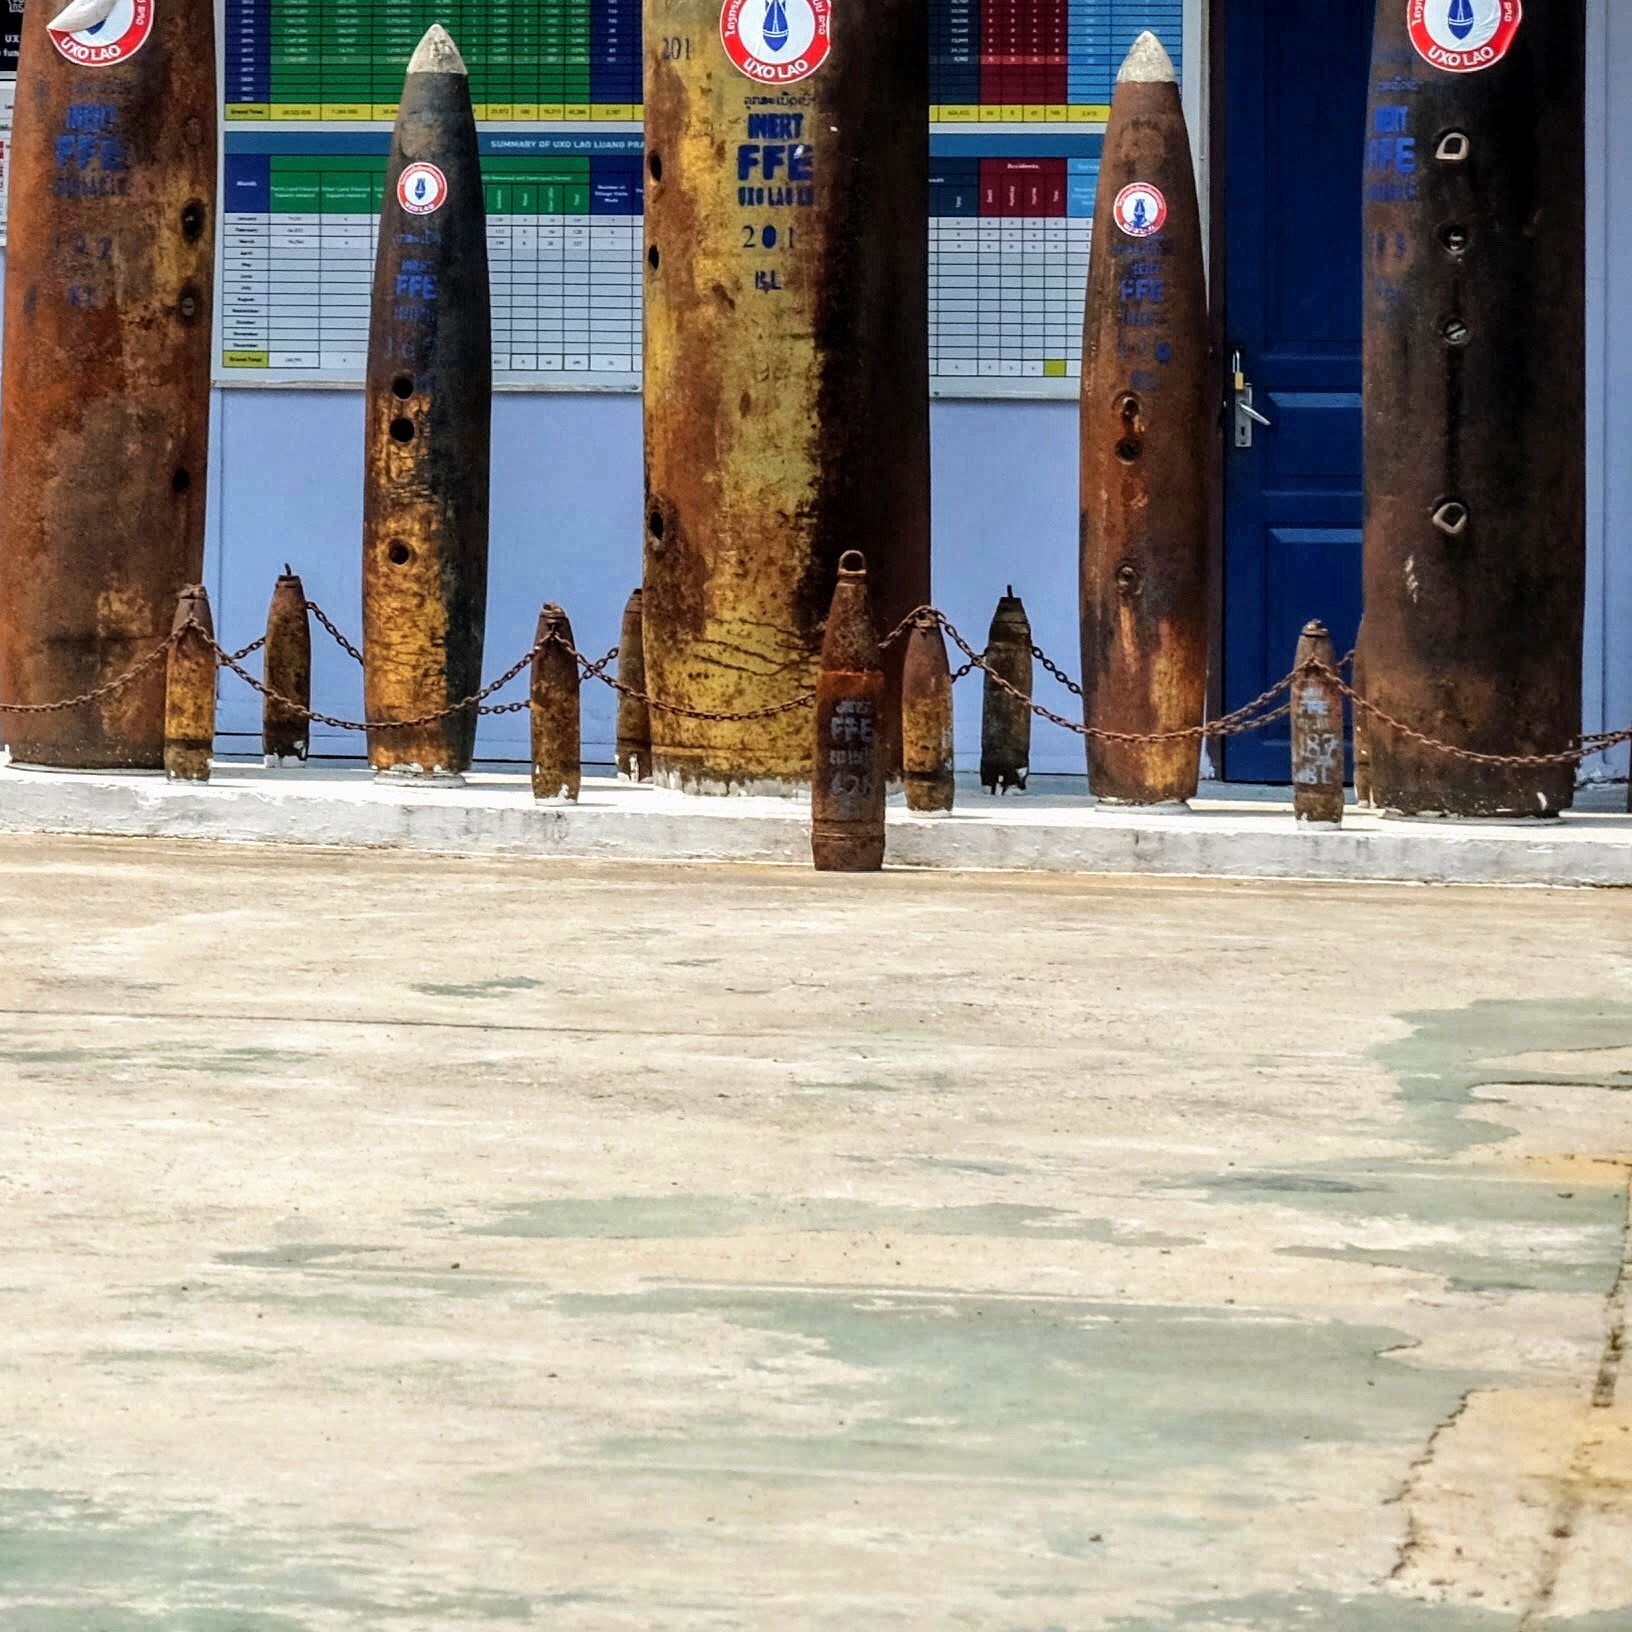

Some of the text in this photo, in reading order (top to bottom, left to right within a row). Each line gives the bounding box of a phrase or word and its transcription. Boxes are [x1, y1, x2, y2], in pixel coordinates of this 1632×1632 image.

[60, 37, 122, 61] UXO LAO
[1428, 45, 1494, 66] UXO LAO
[743, 57, 809, 78] UXO LAO
[490, 140, 536, 149] SUMMARY
[539, 140, 550, 148] OF
[553, 140, 572, 148] UXO
[593, 141, 626, 149] LUANG
[737, 144, 813, 181] FFE
